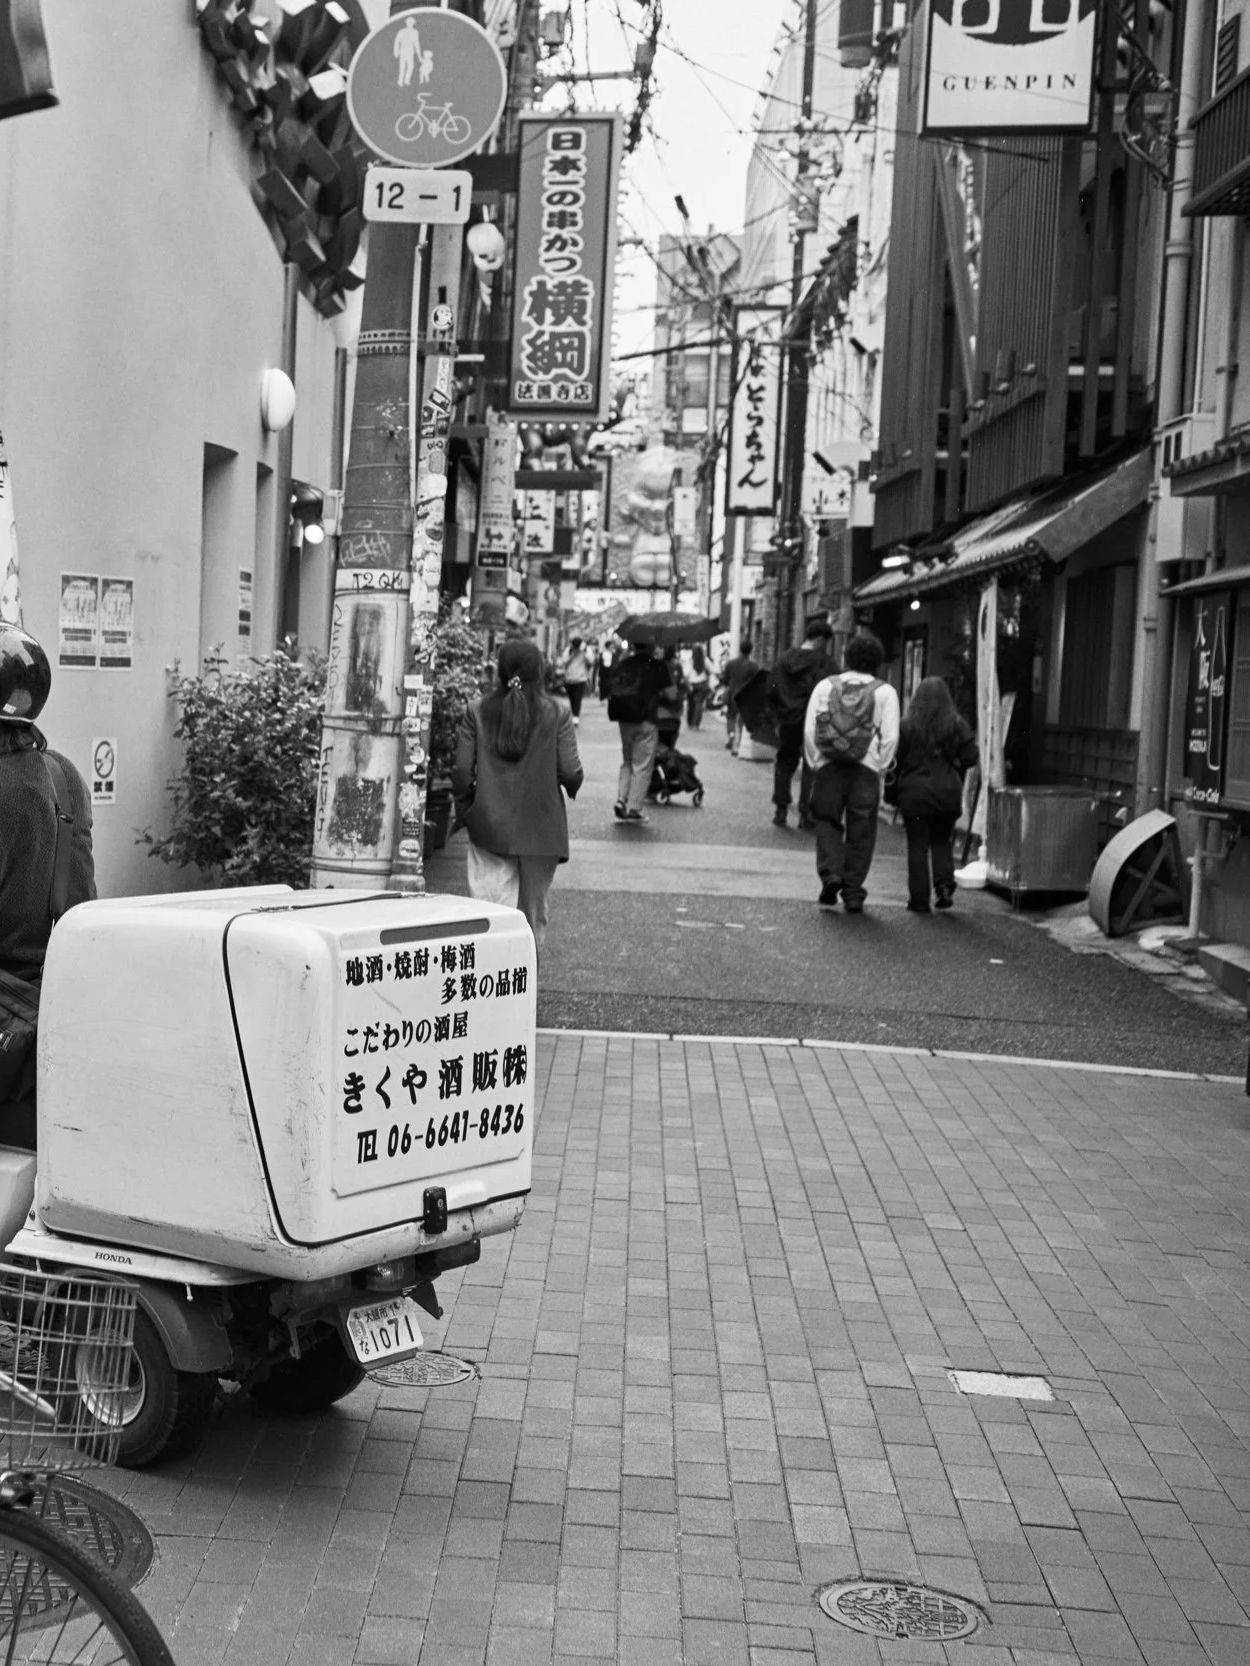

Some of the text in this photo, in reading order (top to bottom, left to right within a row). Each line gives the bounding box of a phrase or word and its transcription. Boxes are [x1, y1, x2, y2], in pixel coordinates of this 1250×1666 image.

[943, 73, 1076, 91] GUENPIN
[540, 126, 587, 276] 日本一の串かつ
[521, 275, 595, 380] 横綱
[344, 1011, 468, 1057] こだわりの酒屋
[387, 1103, 524, 1158] 06-6641-8436
[94, 1251, 132, 1265] HONDA
[370, 1315, 415, 1352] 1071
